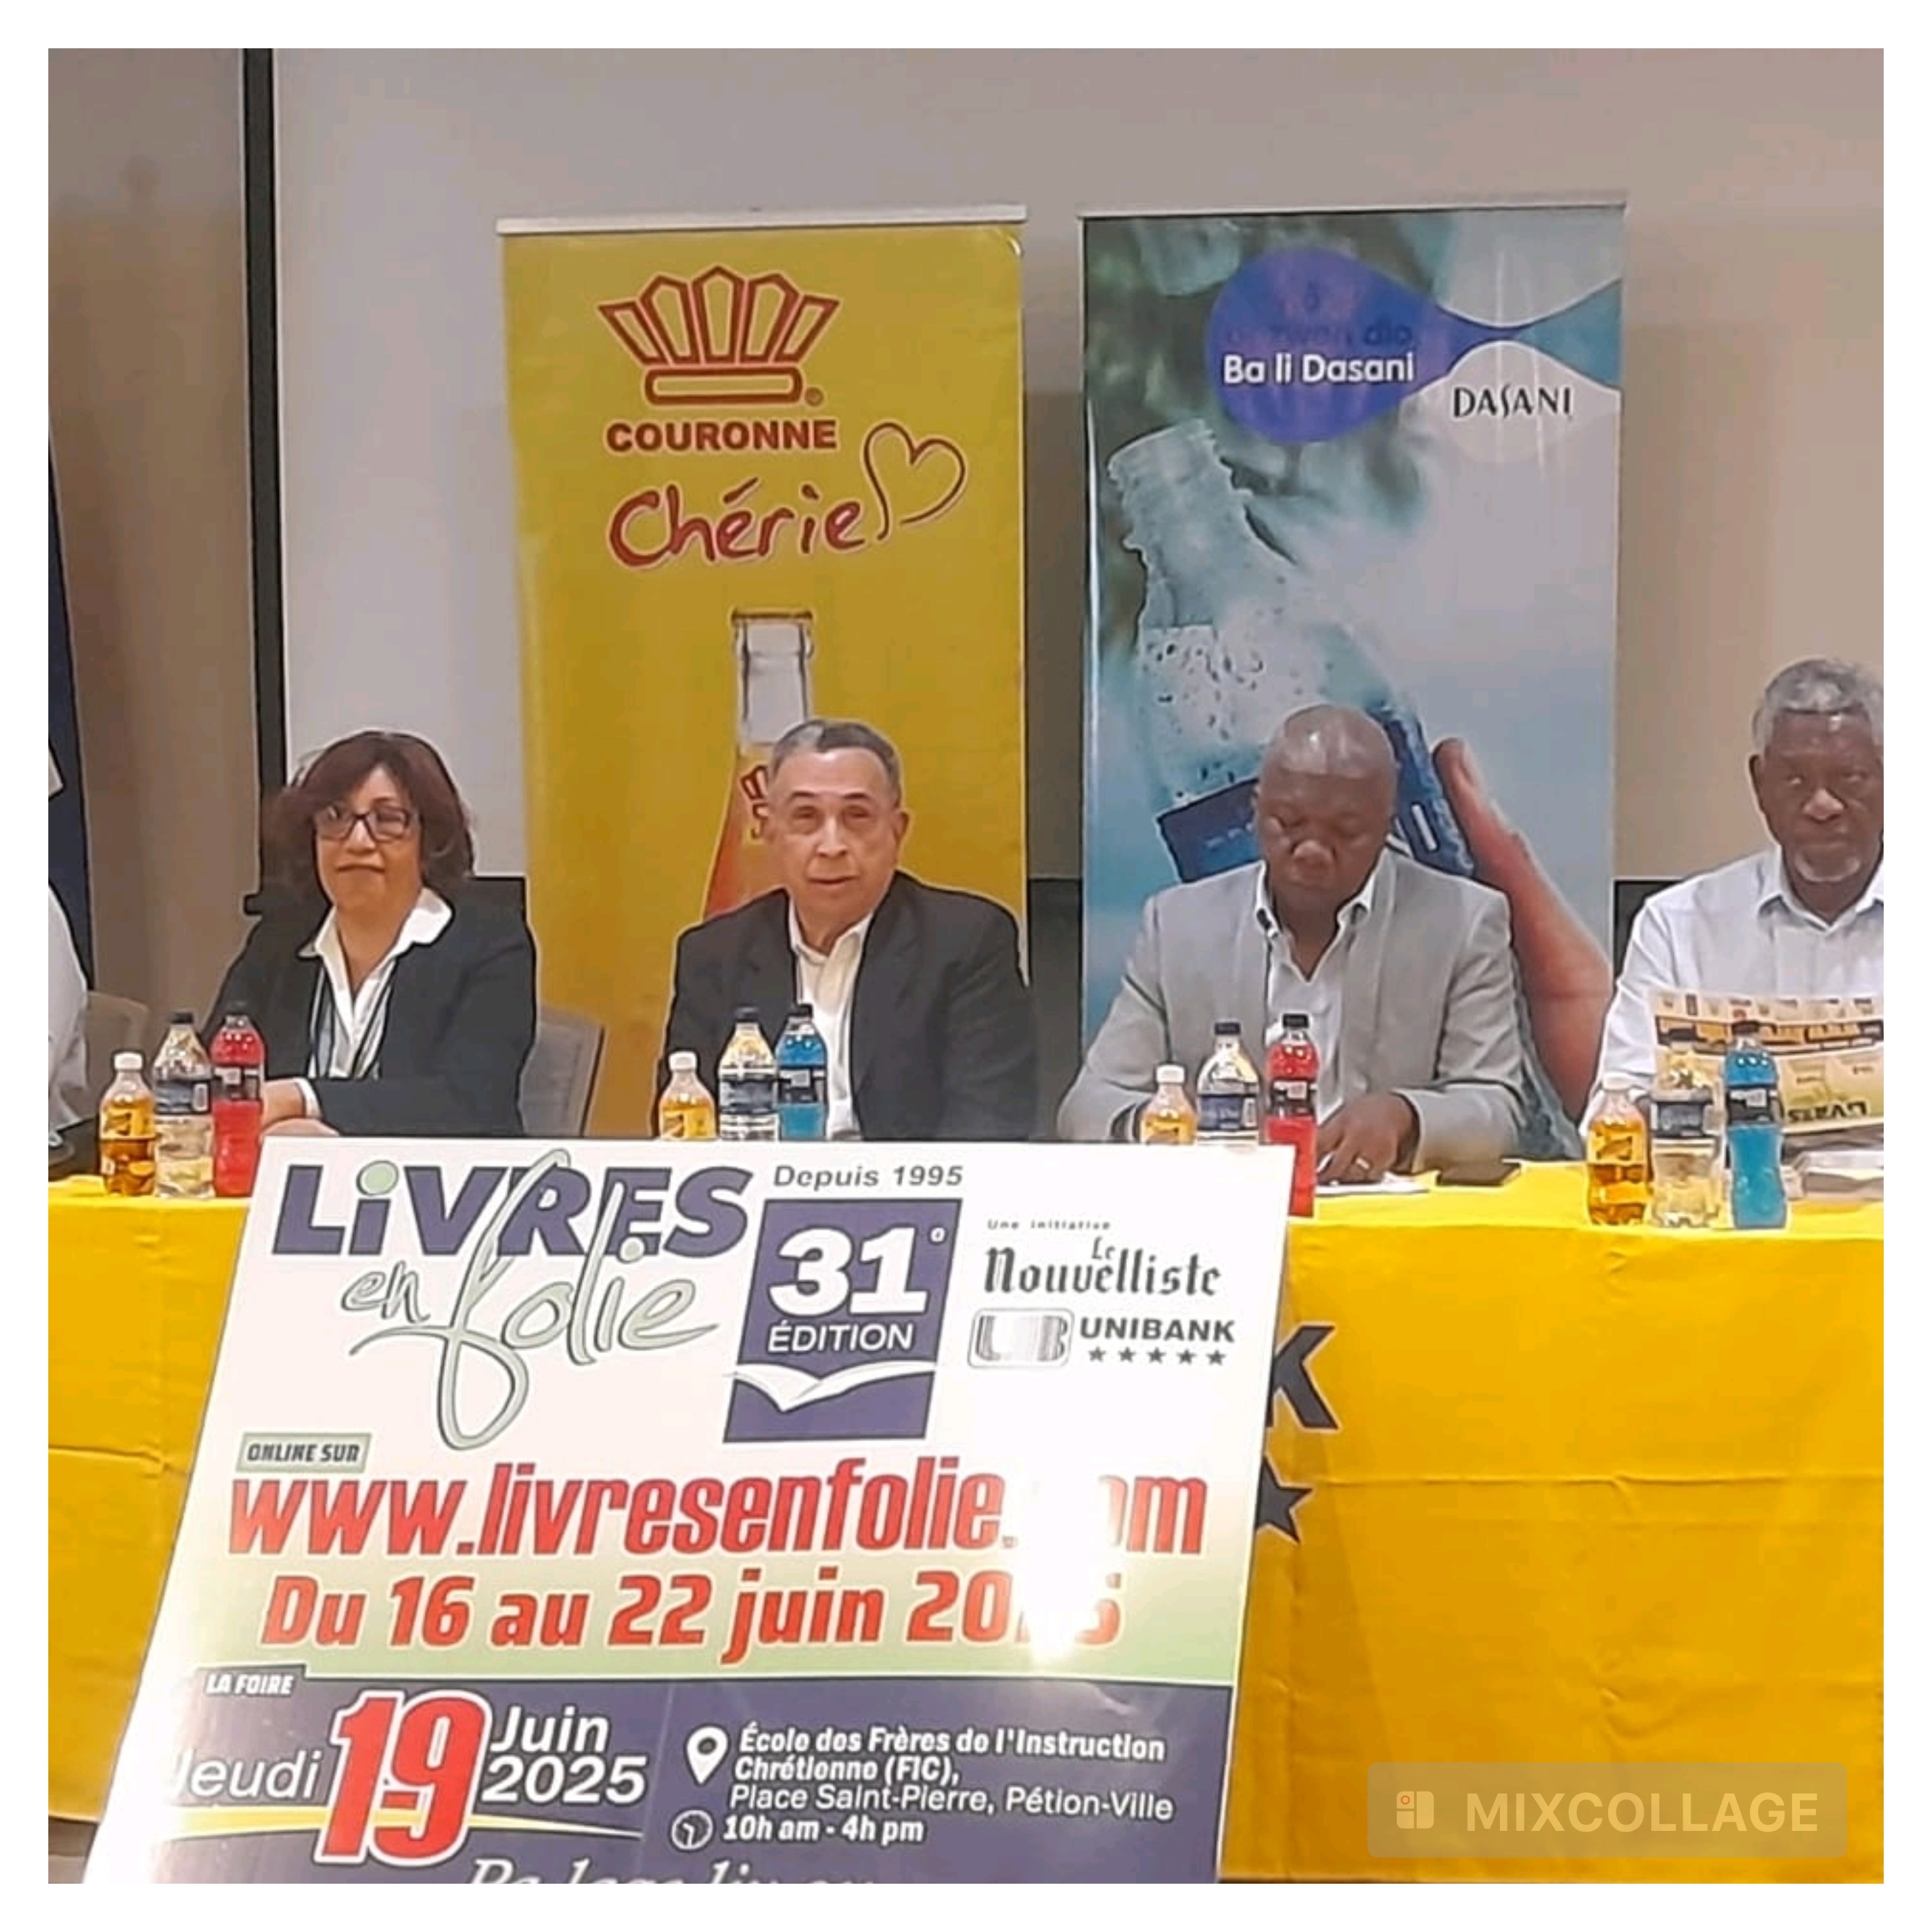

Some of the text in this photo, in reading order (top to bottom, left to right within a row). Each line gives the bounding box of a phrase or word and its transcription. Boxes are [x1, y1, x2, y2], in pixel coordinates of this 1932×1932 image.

[1224, 352, 1415, 383] Ba li Dasani
[1454, 386, 1574, 418] DASANI
[606, 420, 838, 451] COURONNE
[609, 477, 865, 567] Chérie
[773, 1164, 964, 1192] Depuis 1995
[987, 1219, 1112, 1231] Une initiative
[983, 1245, 1221, 1297] Nouvelliste
[341, 1148, 719, 1450] en folie
[768, 1319, 914, 1352] ÉDITION
[1079, 1316, 1236, 1343] UNIBANK
[247, 1443, 359, 1463] ONLINE SUR
[229, 1456, 1207, 1555] www.livresenfolie.m
[261, 1575, 367, 1645] Du
[390, 1575, 475, 1646] 16
[490, 1594, 590, 1646] au
[607, 1575, 712, 1646] 22
[721, 1567, 886, 1665] juin
[206, 1674, 294, 1695] LA FOIRE
[490, 1705, 609, 1752] Juin
[316, 1692, 491, 1864] 19
[482, 1754, 647, 1804] 2025
[884, 1756, 960, 1786] (FIC),
[730, 1784, 1175, 1821] Place Saint-Pierre, Pétion-Ville
[723, 1814, 773, 1841] 10h
[778, 1821, 820, 1841] am
[840, 1814, 876, 1841] 4h
[881, 1821, 925, 1846] pm
